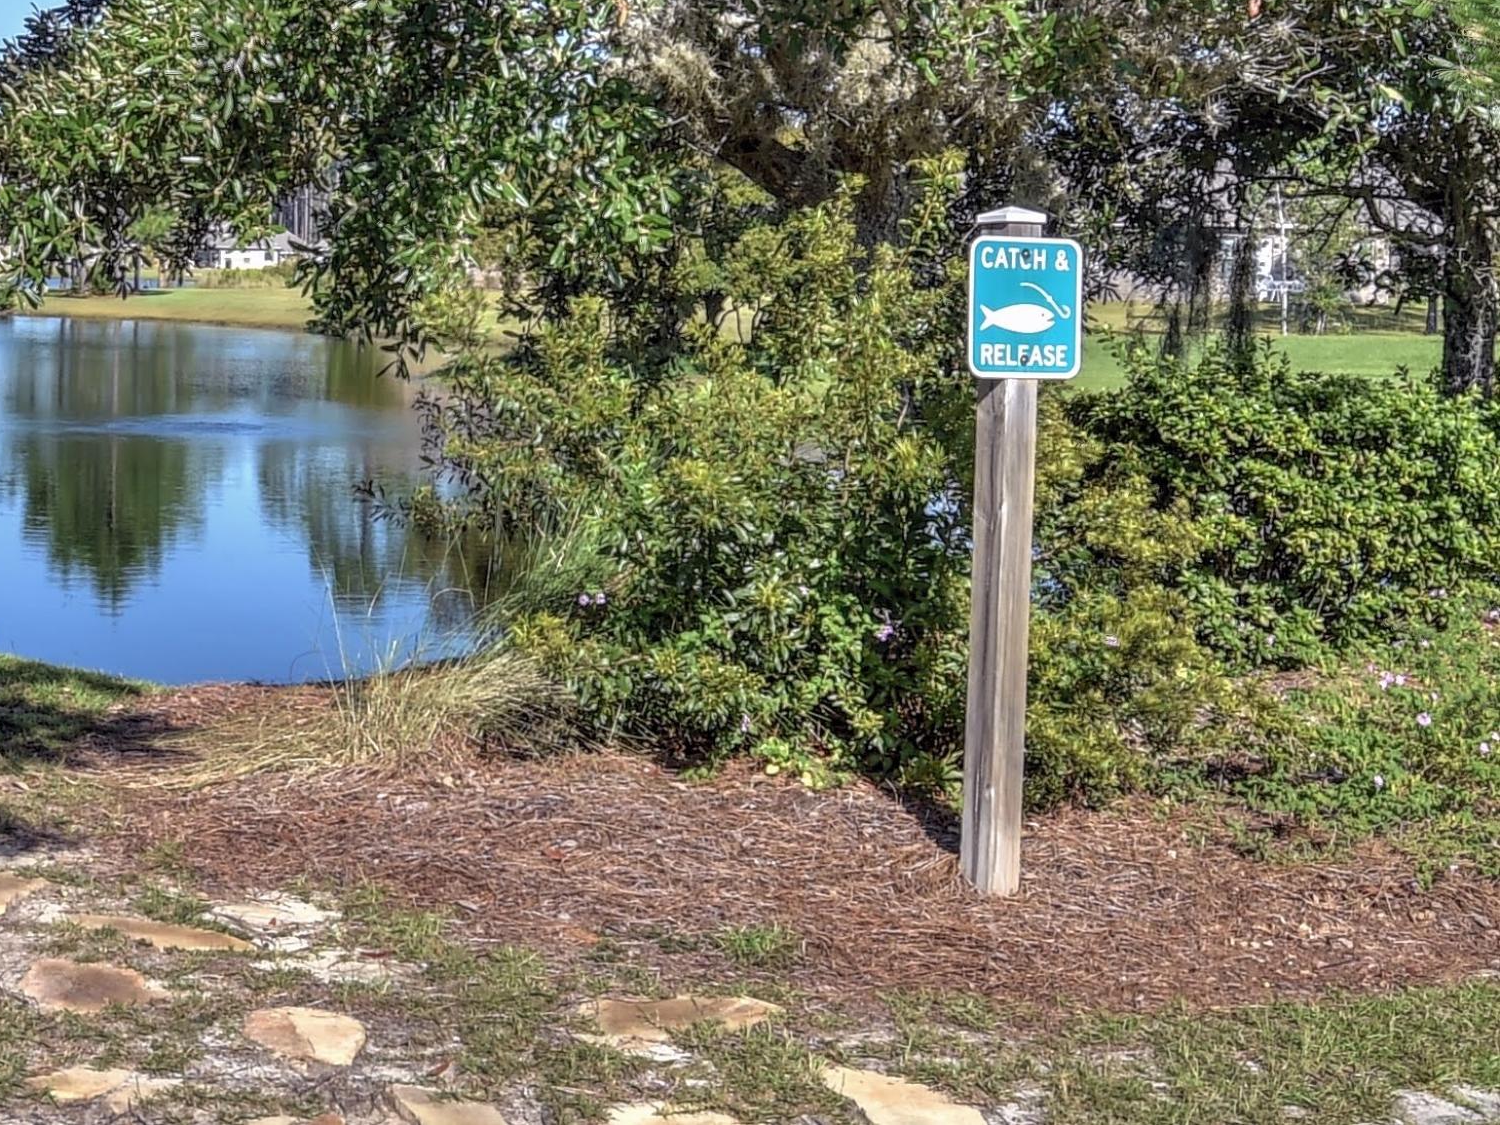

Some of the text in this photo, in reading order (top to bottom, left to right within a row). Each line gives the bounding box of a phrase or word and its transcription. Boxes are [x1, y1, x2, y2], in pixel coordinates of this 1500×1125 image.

[981, 247, 1070, 272] CATCH &
[980, 344, 1068, 367] RELEASE
